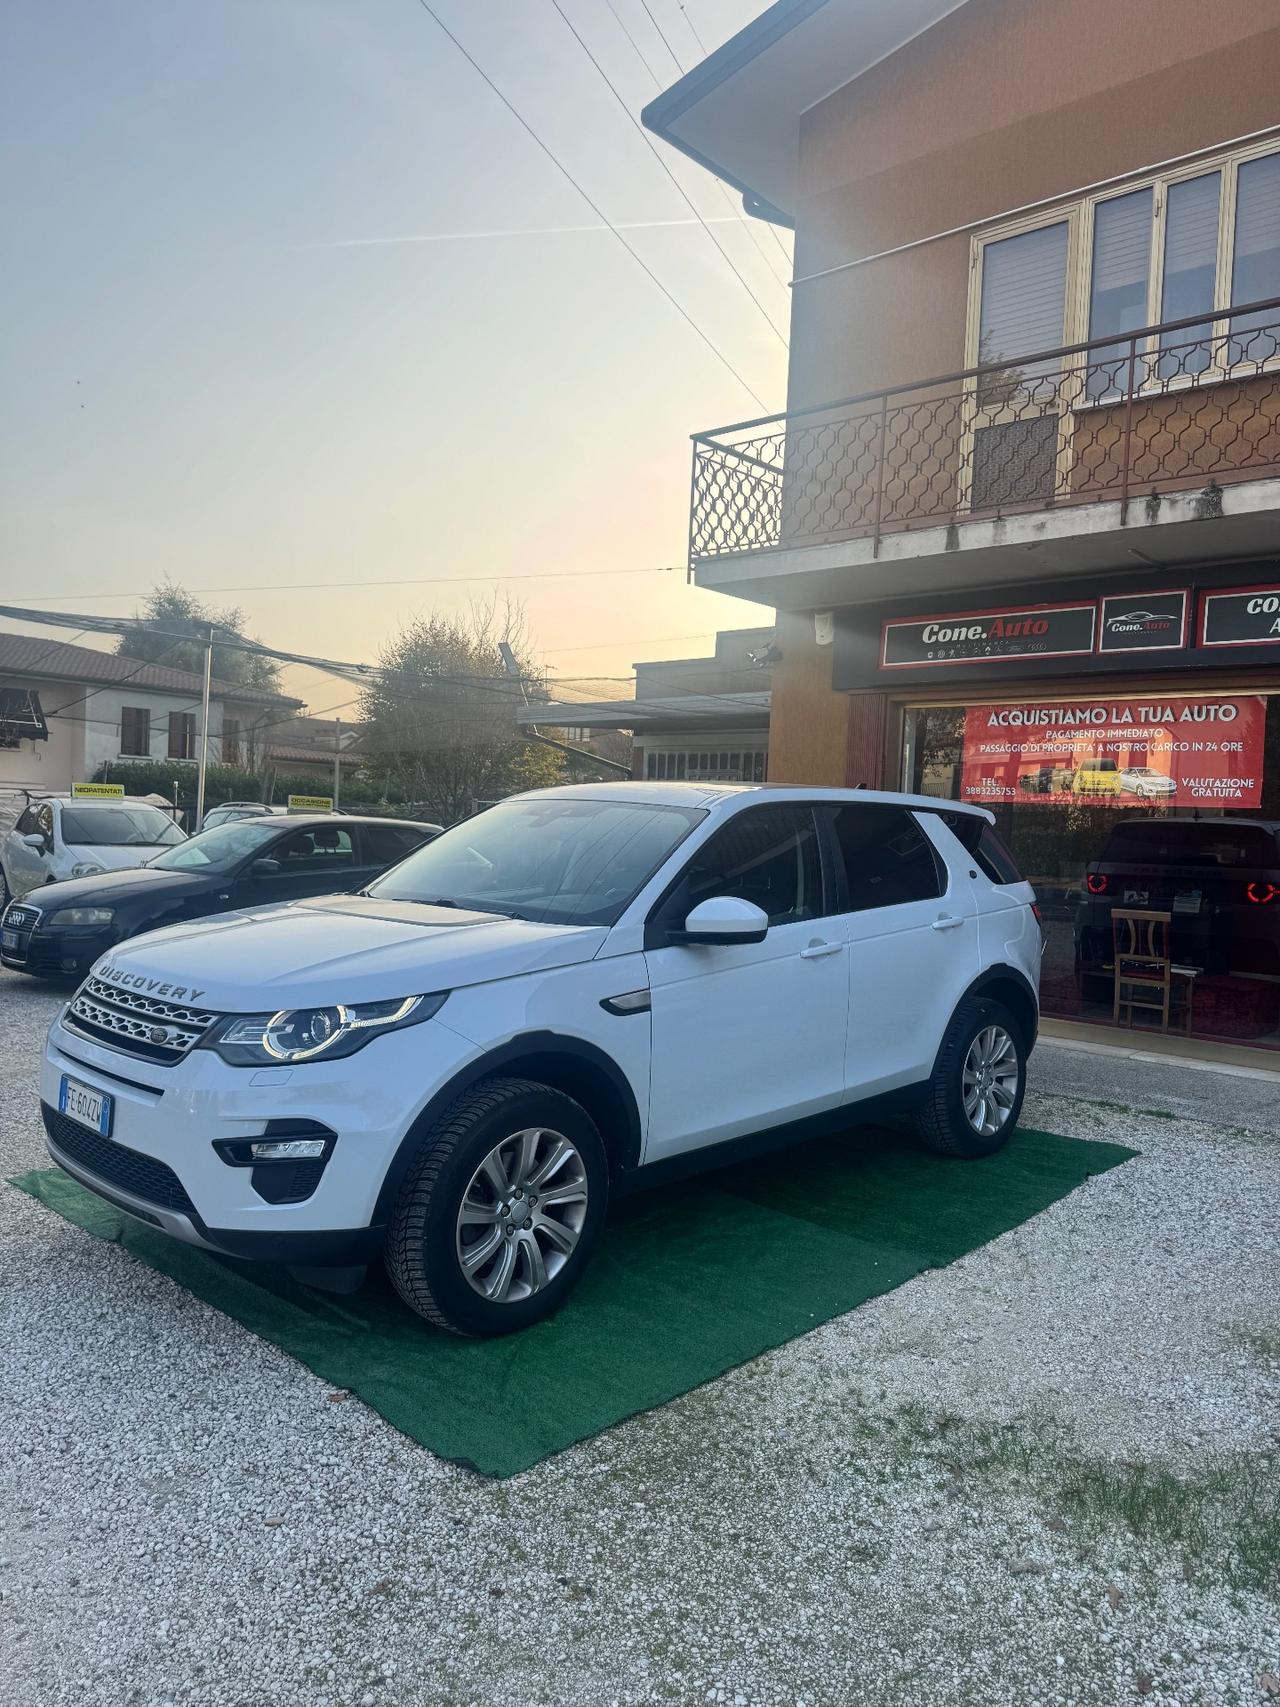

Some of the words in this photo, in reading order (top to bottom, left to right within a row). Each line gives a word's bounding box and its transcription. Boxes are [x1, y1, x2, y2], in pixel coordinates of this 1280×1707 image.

[1246, 597, 1280, 615] CO
[922, 618, 1049, 643] Cone.Auto
[987, 707, 1108, 727] ACQUISTIAMO
[1111, 706, 1135, 724] LA
[1138, 706, 1175, 723] TUA
[1179, 704, 1238, 722] AUTO
[1046, 729, 1105, 739] PAGAMENTO
[1107, 728, 1164, 738] IMMEDIATO
[980, 743, 1029, 753] PASSAGGIO
[1031, 743, 1040, 752] DI
[1097, 743, 1105, 752] A
[1106, 742, 1149, 752] NOSTRO
[1151, 742, 1189, 751] CARICO
[1192, 742, 1203, 751] IN
[1205, 742, 1218, 751] 24
[1220, 742, 1243, 751] ORE
[1182, 777, 1255, 788] VALUTAZIONE
[965, 786, 1016, 796] 3883235753
[1191, 788, 1243, 798] GRATUITA
[98, 966, 207, 1002] DISCOVERY
